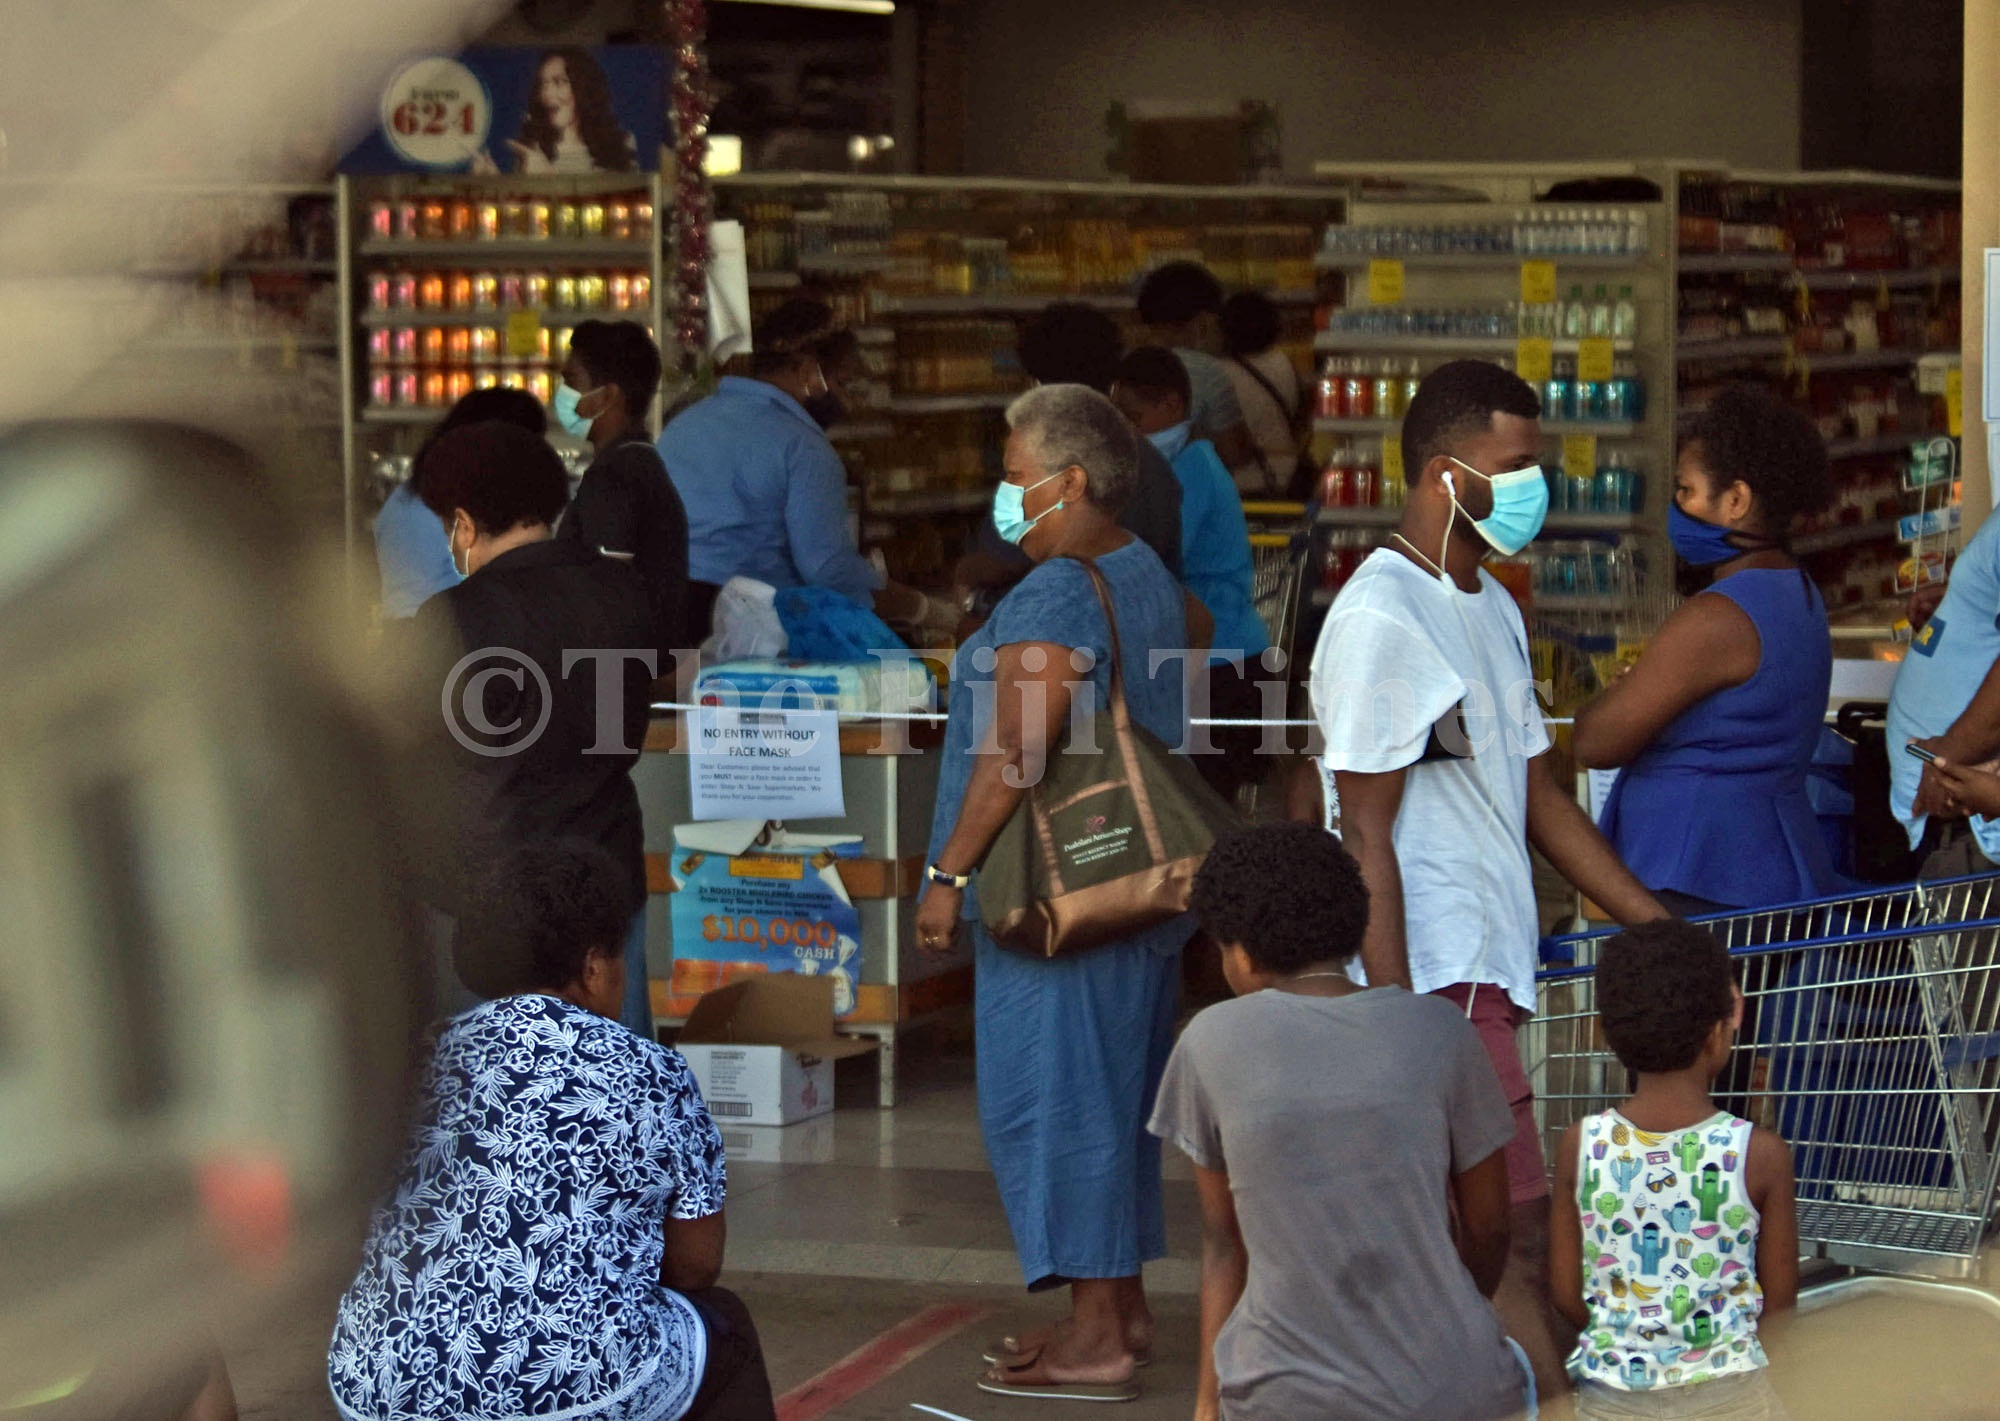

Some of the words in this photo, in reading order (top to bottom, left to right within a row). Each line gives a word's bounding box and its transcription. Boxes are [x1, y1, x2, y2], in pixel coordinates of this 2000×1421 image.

[704, 728, 721, 738] NO
[724, 729, 759, 739] ENTRY
[762, 730, 816, 740] WITHOUT
[729, 747, 756, 756] FACE
[759, 747, 791, 758] MASK
[710, 887, 748, 896] ROOSTER
[703, 913, 836, 952] $10,000
[794, 947, 835, 959] CASH
